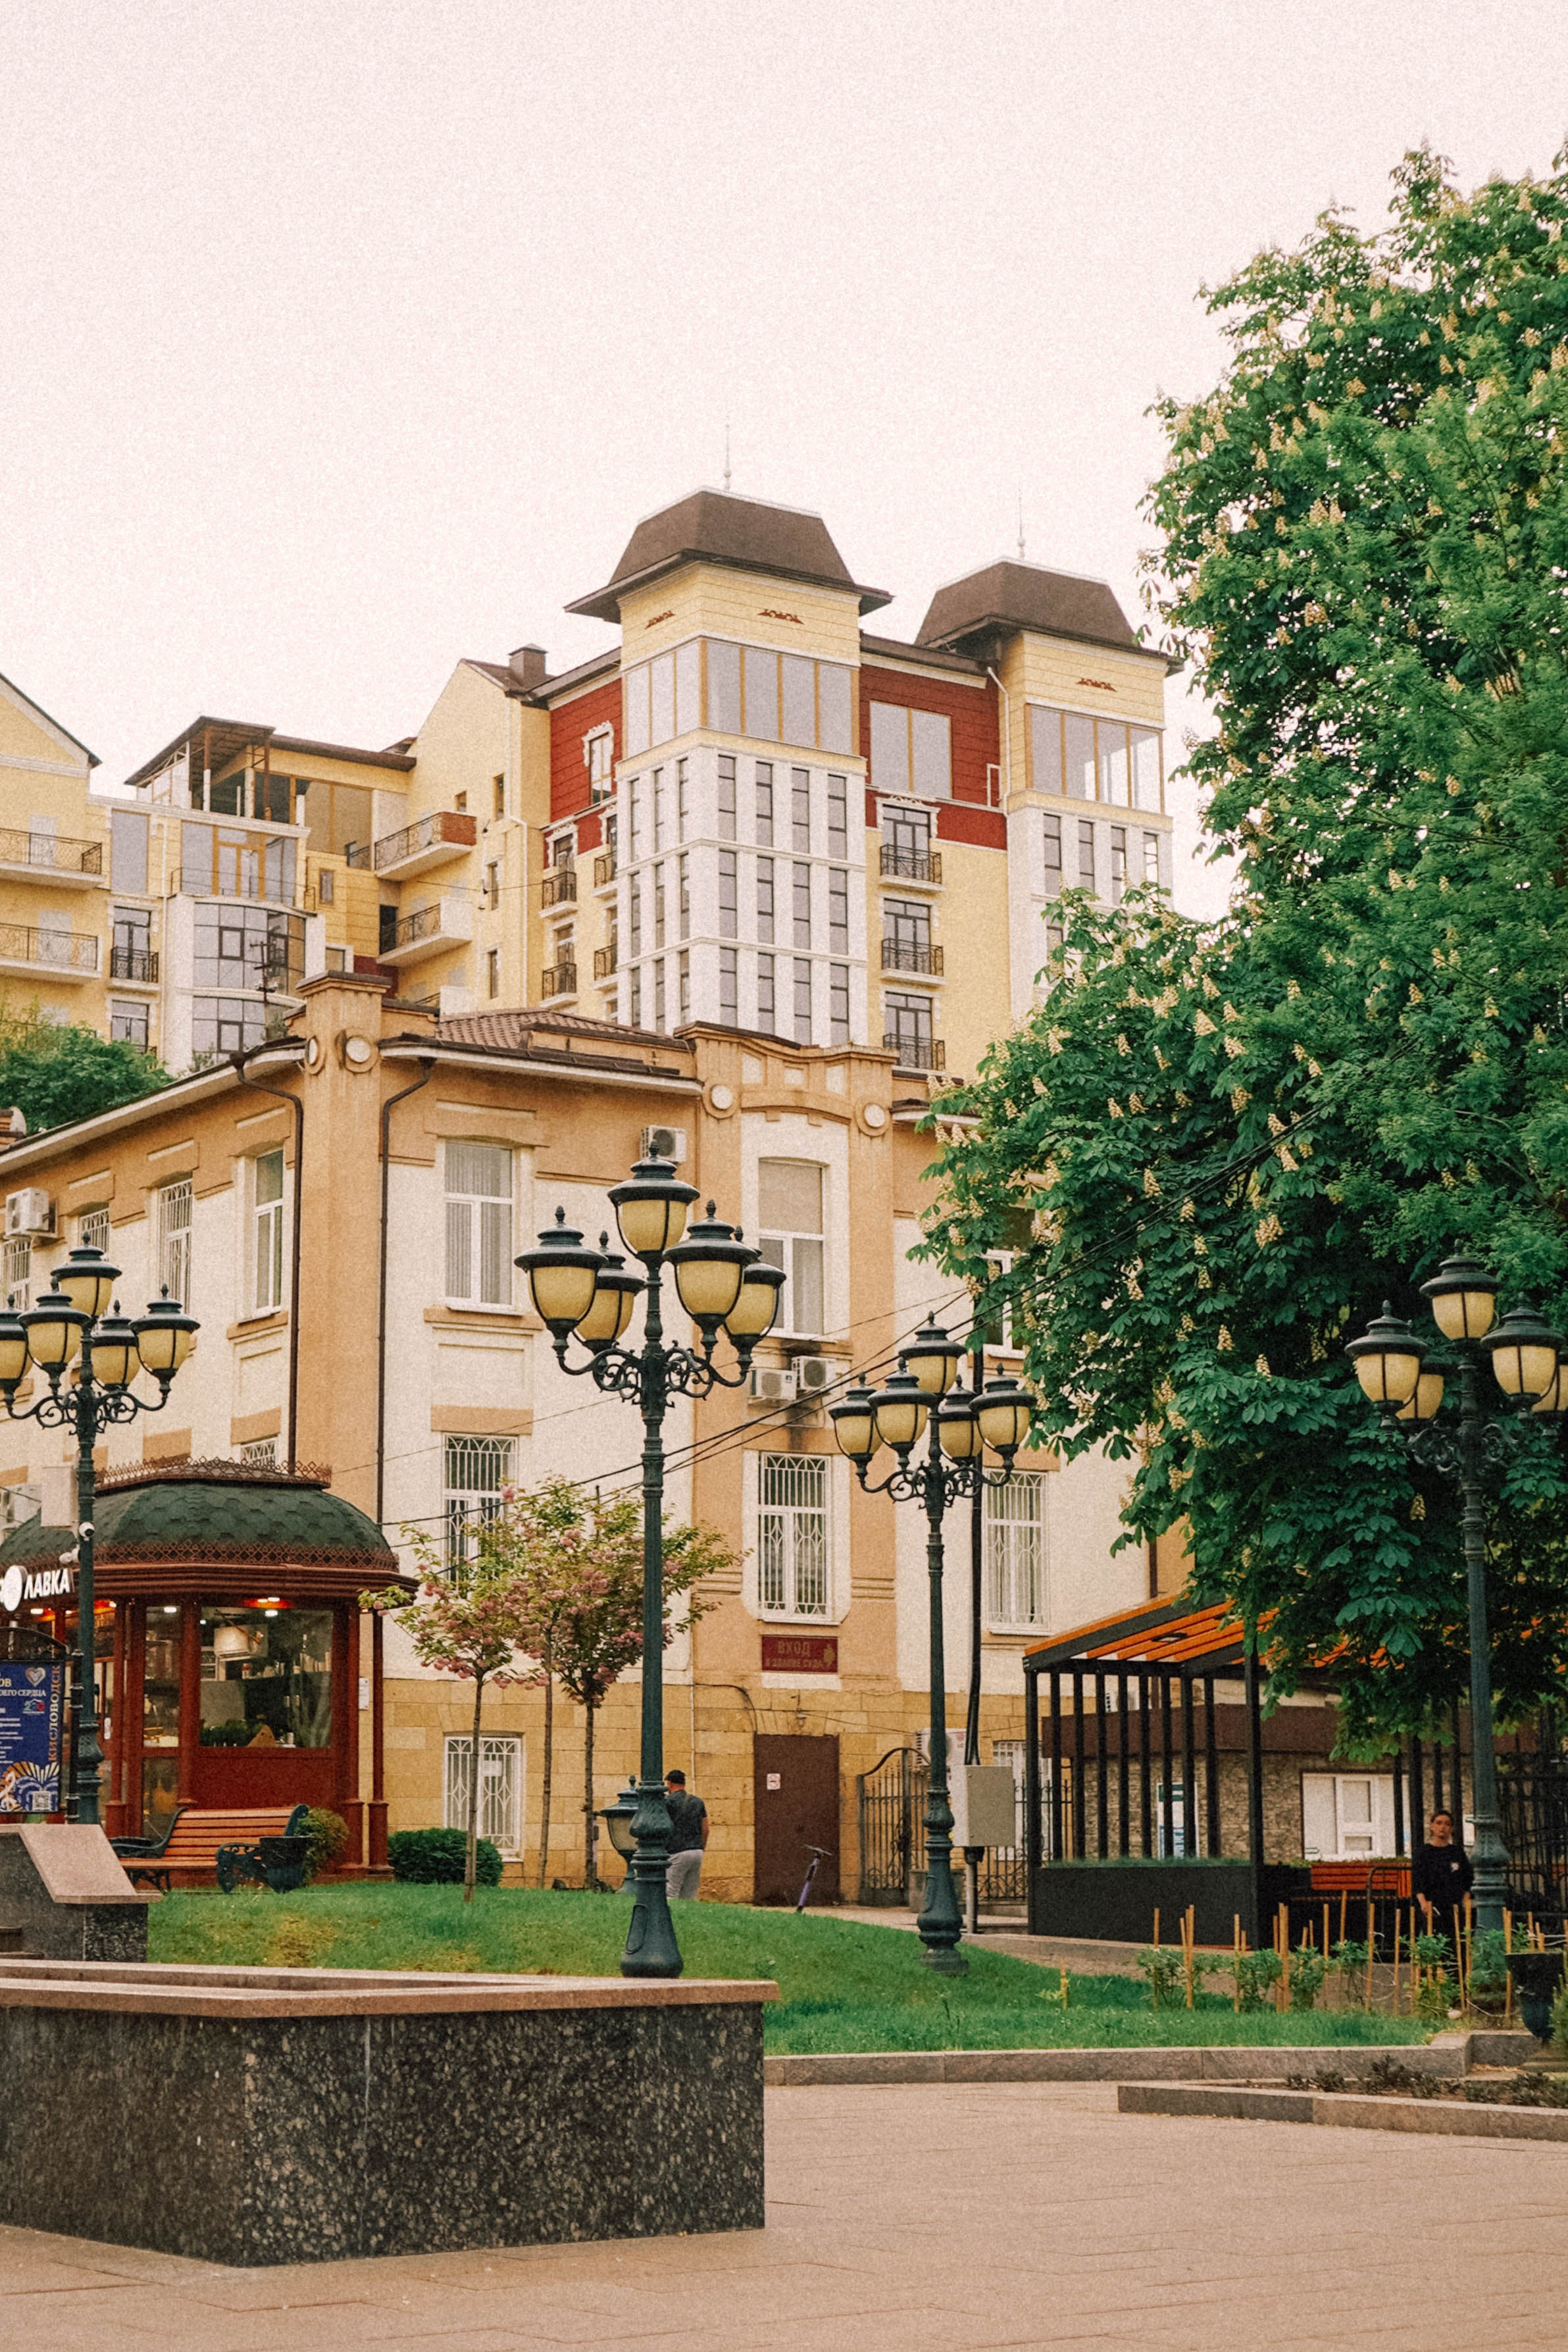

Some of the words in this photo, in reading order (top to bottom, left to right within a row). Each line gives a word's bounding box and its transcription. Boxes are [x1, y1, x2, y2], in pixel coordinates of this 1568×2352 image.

[24, 1568, 70, 1599] ЛАВКА
[778, 1641, 810, 1657] ВХОД
[48, 1666, 61, 1761] КИСЛОВОДСК
